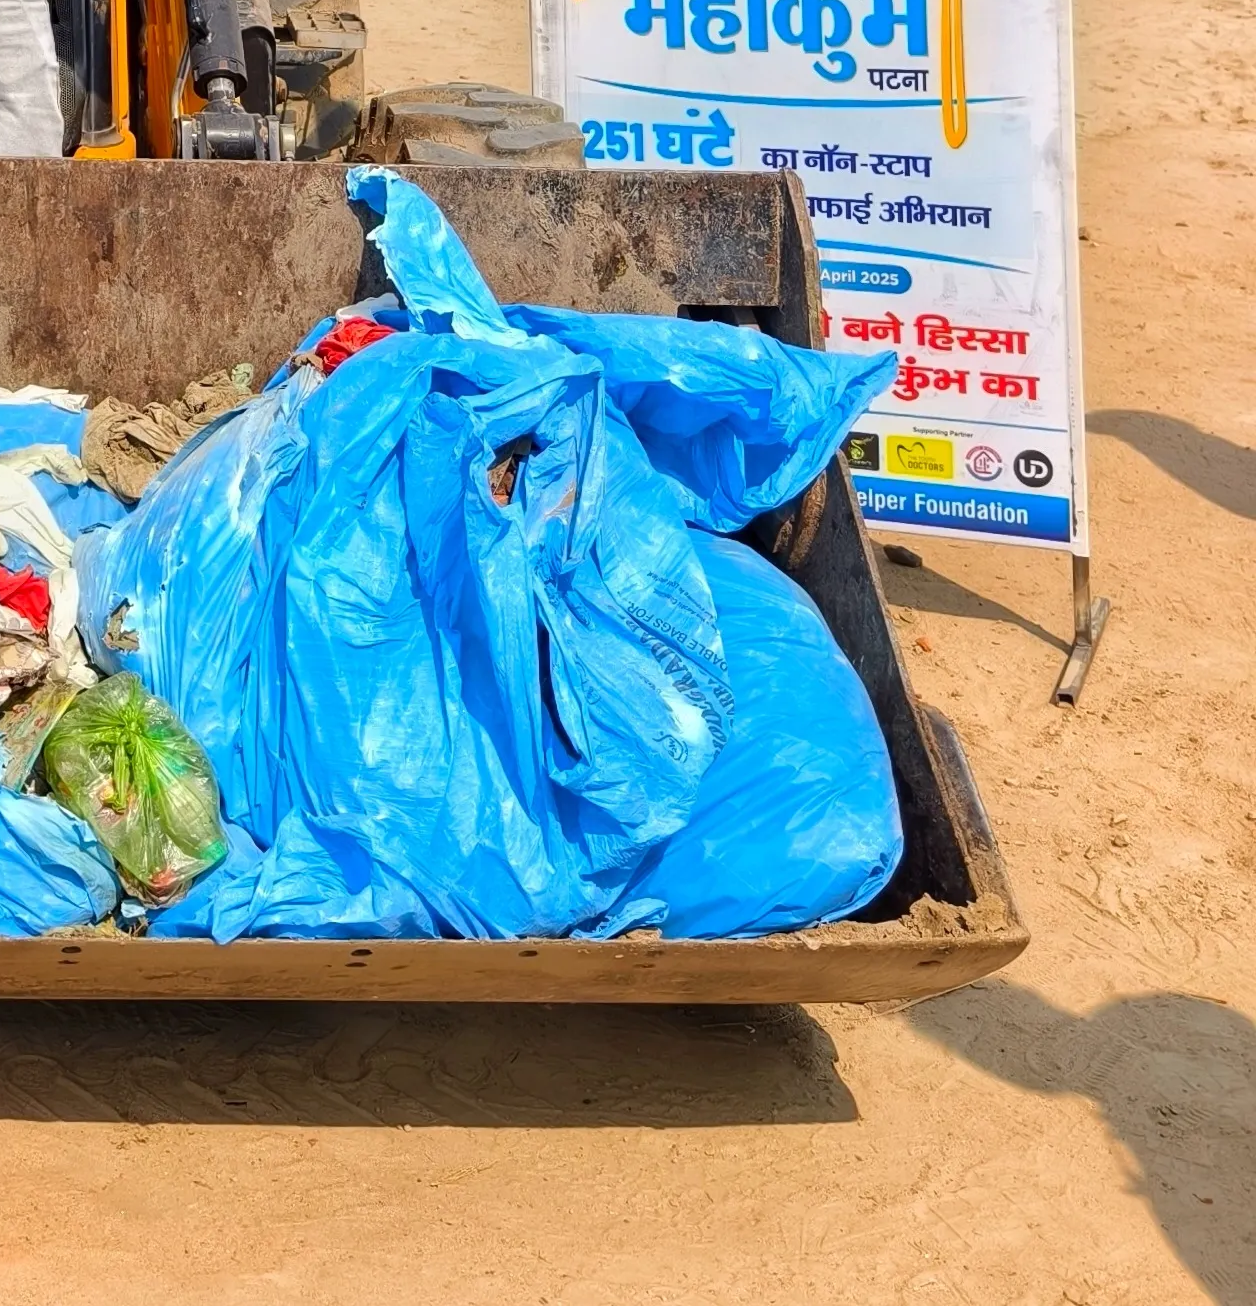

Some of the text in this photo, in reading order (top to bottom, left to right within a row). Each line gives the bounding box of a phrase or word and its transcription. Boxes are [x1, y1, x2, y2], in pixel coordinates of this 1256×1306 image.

[867, 68, 929, 92] पटना
[582, 107, 735, 166] 251 घंटे
[761, 146, 799, 170] का
[879, 195, 992, 229] अभियान
[820, 268, 899, 286] April 2025
[842, 311, 904, 344] बने
[914, 313, 1030, 355] हिस्सा
[980, 372, 1040, 401] का
[913, 426, 974, 439] Supporting Partner
[908, 460, 944, 472] DOCTORS
[857, 488, 1029, 525] elper Foundation
[653, 616, 687, 644] BAGS
